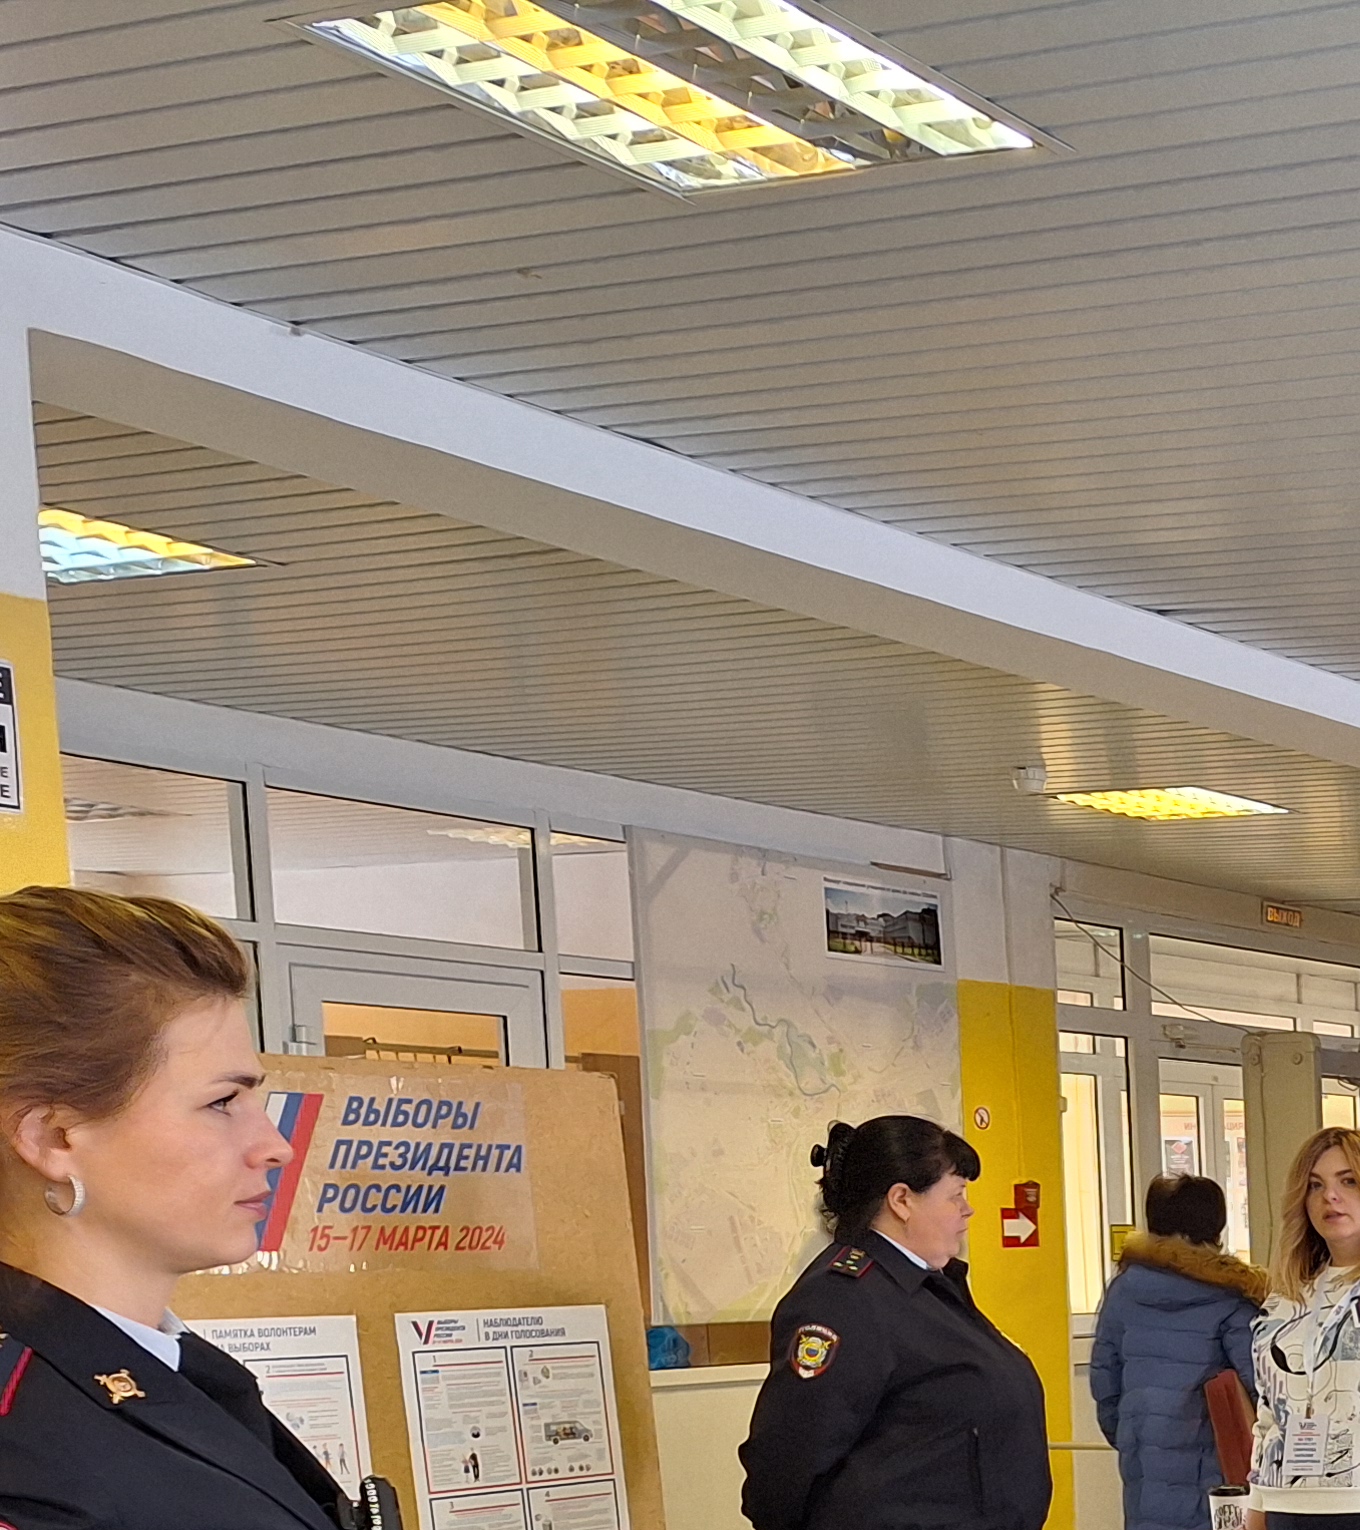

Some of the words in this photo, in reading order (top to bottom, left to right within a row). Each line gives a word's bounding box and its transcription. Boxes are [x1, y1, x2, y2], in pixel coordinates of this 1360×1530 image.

[1267, 907, 1300, 928] ВЫХОД
[341, 1096, 481, 1131] ВЫБОРЫ
[328, 1140, 523, 1177] ПРЕЗИДЕНТА
[317, 1183, 446, 1215] РОССИИ
[376, 1225, 449, 1251] МАРТА
[456, 1225, 506, 1250] 2024
[212, 1329, 255, 1339] ПАМЯТКА
[258, 1326, 317, 1338] ВОЛОНТЕРАМ
[483, 1316, 543, 1328] НАБЛЮДАТЕЛЮ
[485, 1333, 490, 1341] В
[492, 1332, 509, 1341] ДНИ
[511, 1328, 565, 1339] ГОЛОСОВАНИЯ
[228, 1342, 271, 1352] ВЫБОРАХ
